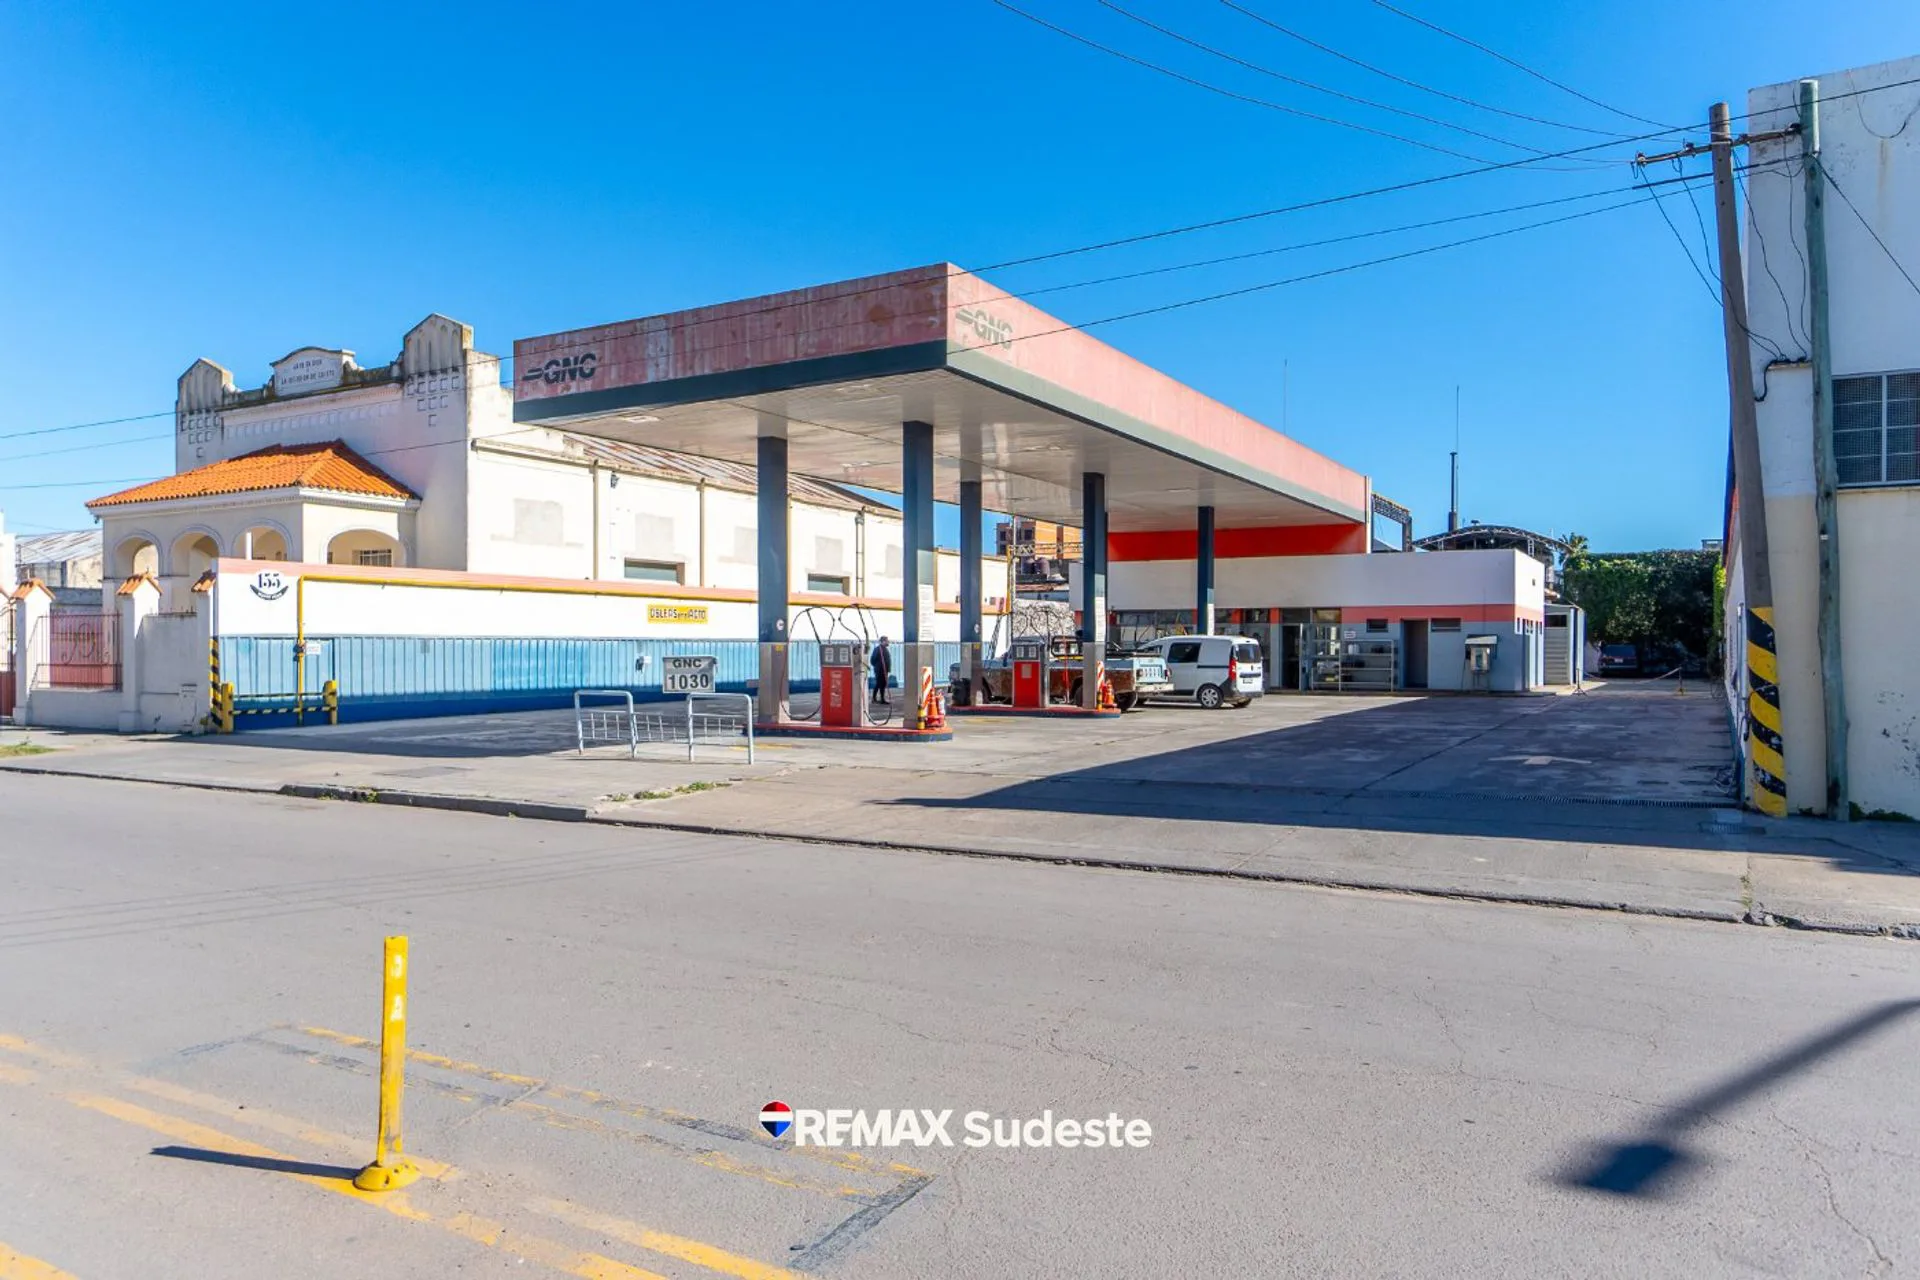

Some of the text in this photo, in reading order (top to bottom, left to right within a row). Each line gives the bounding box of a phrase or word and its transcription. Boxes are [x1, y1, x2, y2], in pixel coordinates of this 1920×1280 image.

[973, 309, 1013, 350] GNC
[544, 352, 597, 384] GNC
[258, 572, 281, 588] 155
[672, 659, 702, 668] GNC
[668, 673, 709, 690] 1030
